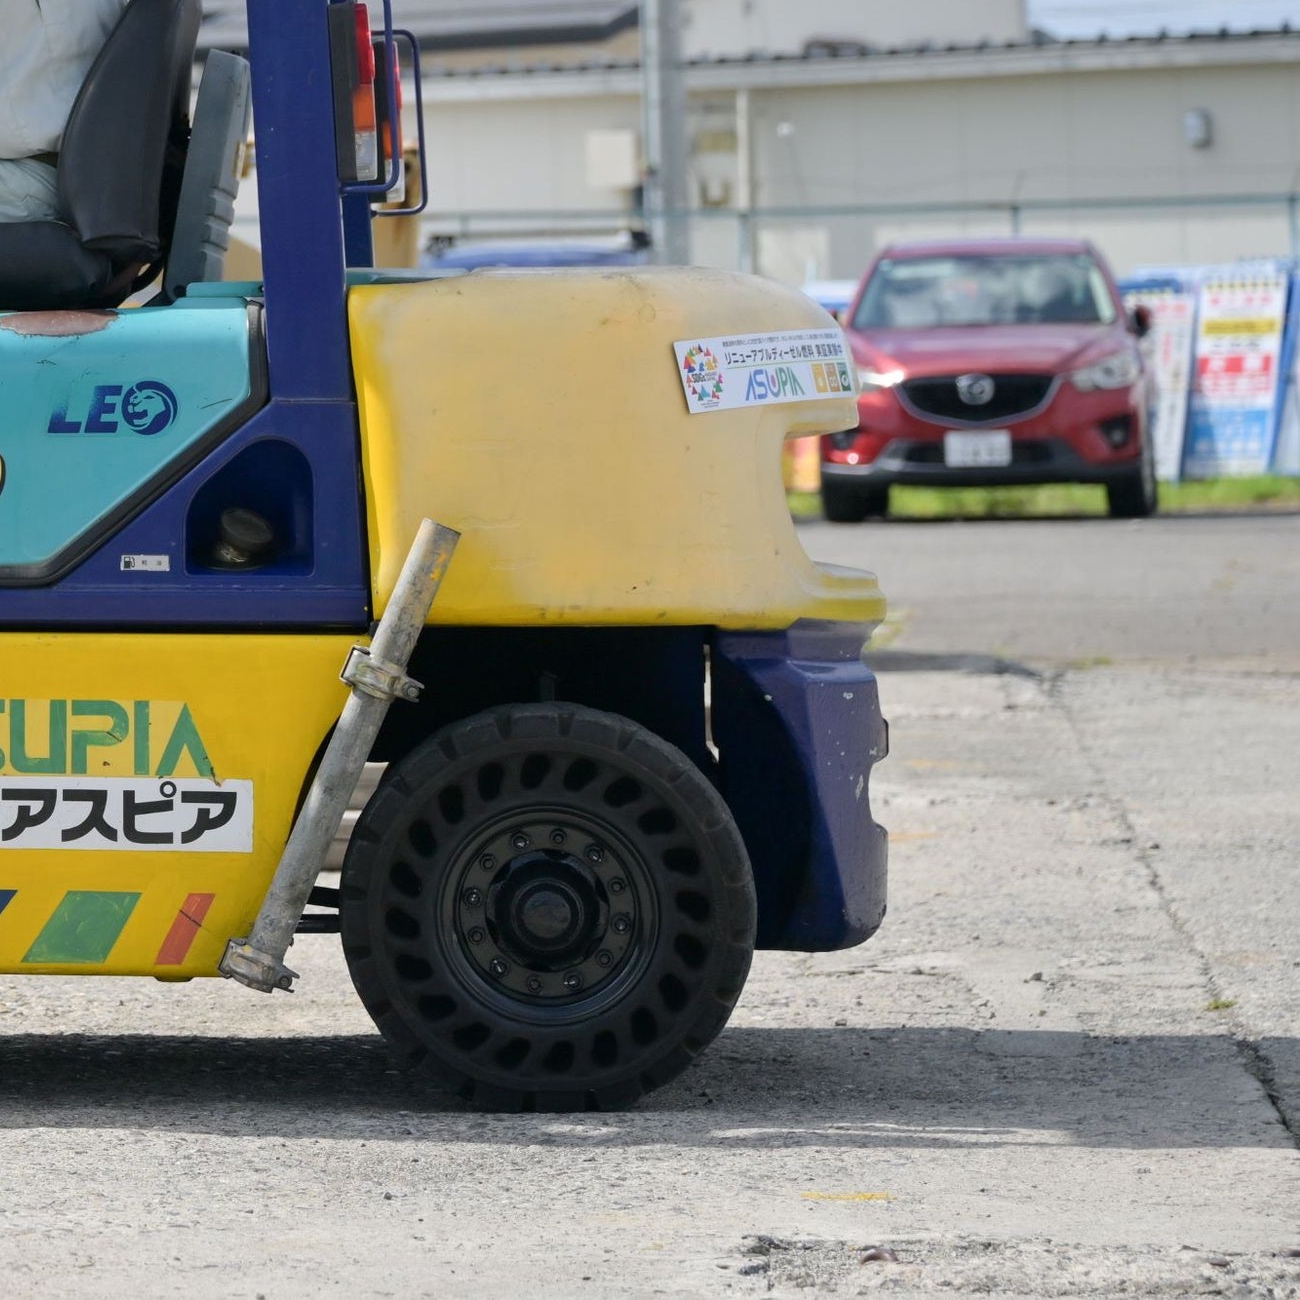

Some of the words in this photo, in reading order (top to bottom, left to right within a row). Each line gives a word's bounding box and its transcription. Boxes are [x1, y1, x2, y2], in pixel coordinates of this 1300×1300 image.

[46, 379, 179, 436] LEO
[745, 366, 806, 402] ASUPIA
[0, 780, 238, 845] アスピア
